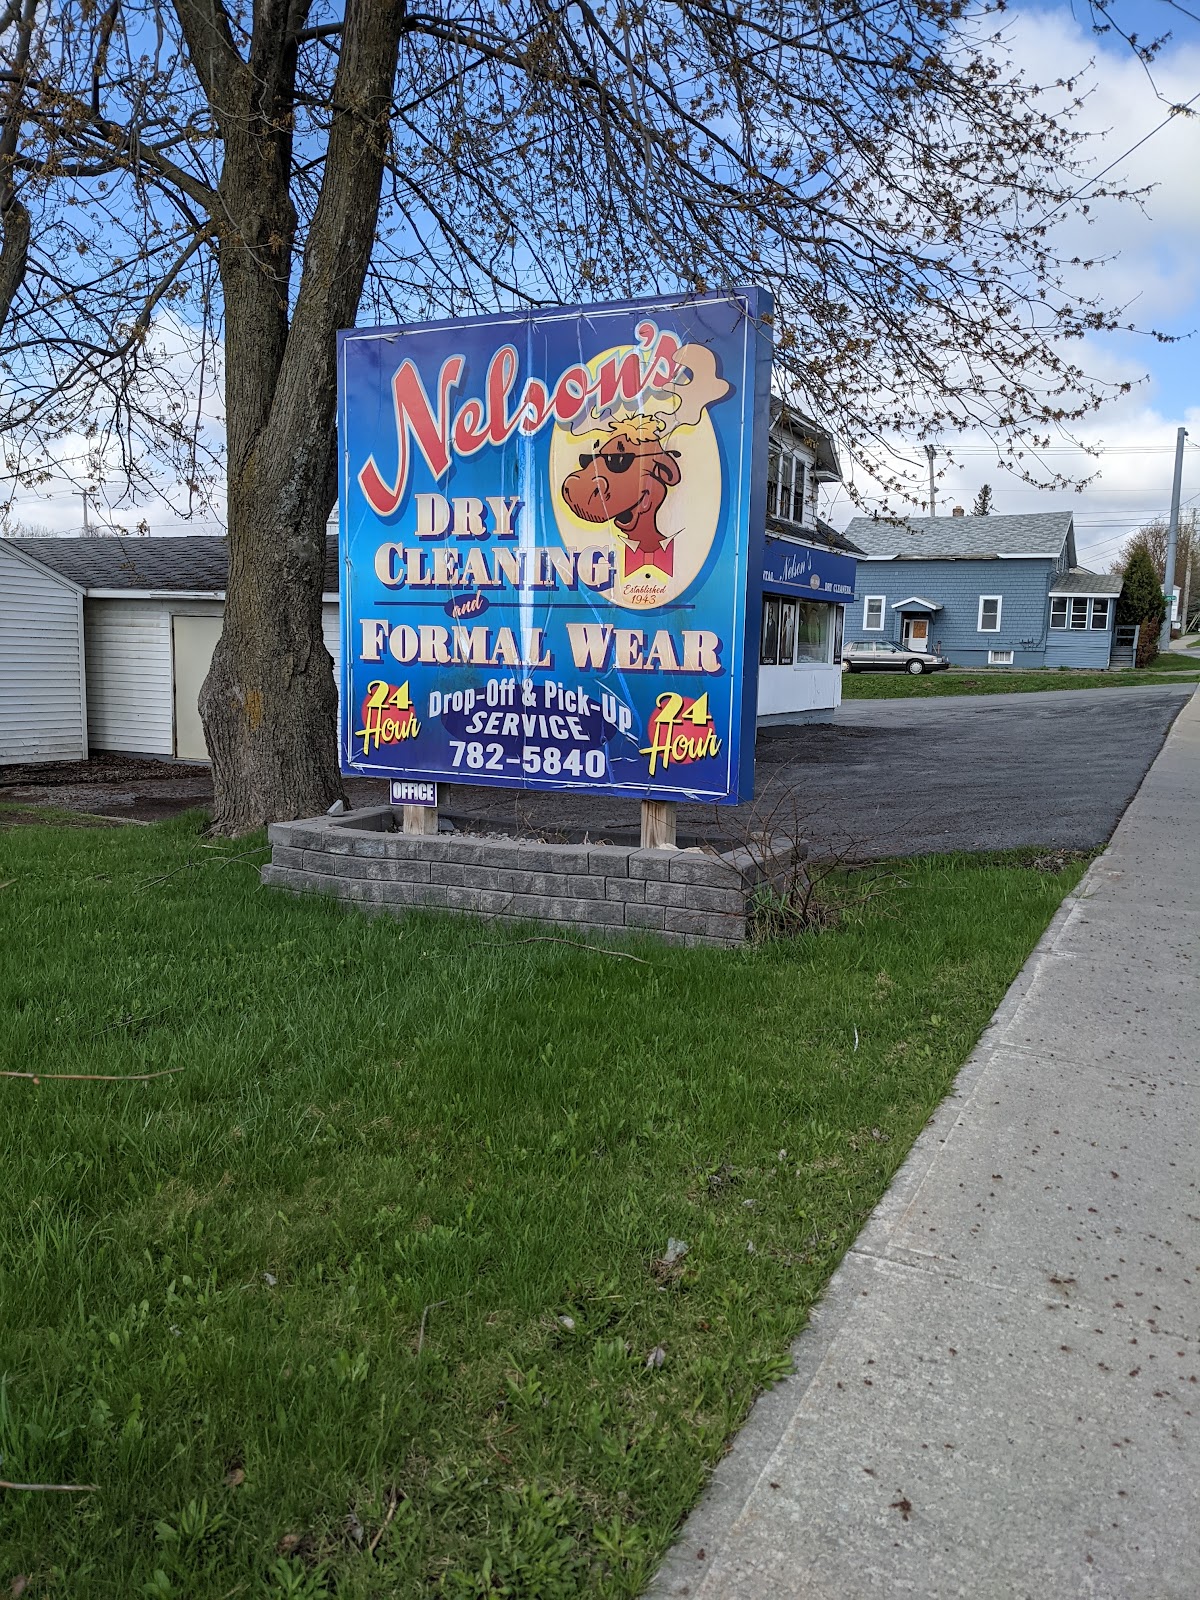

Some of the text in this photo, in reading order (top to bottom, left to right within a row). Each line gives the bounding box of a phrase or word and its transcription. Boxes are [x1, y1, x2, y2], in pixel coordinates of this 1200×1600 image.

[357, 318, 683, 516] Nelson's
[414, 493, 523, 539] DRY
[374, 542, 616, 590] CLEANING
[780, 551, 812, 582] Nelson's
[450, 590, 484, 619] and
[623, 584, 667, 595] Established
[631, 594, 657, 604] 1943
[824, 582, 852, 595] DRY CLEANERS
[359, 618, 723, 674] FORMAL WEAR
[366, 680, 413, 710] 24
[428, 678, 633, 731] Drop-Off & Pick-Up
[655, 692, 712, 725] 24
[355, 704, 422, 756] Hour
[465, 710, 591, 741] SERVICE
[449, 740, 606, 778] 782-5840
[639, 719, 722, 776] Hour
[392, 781, 435, 801] OFFICE
